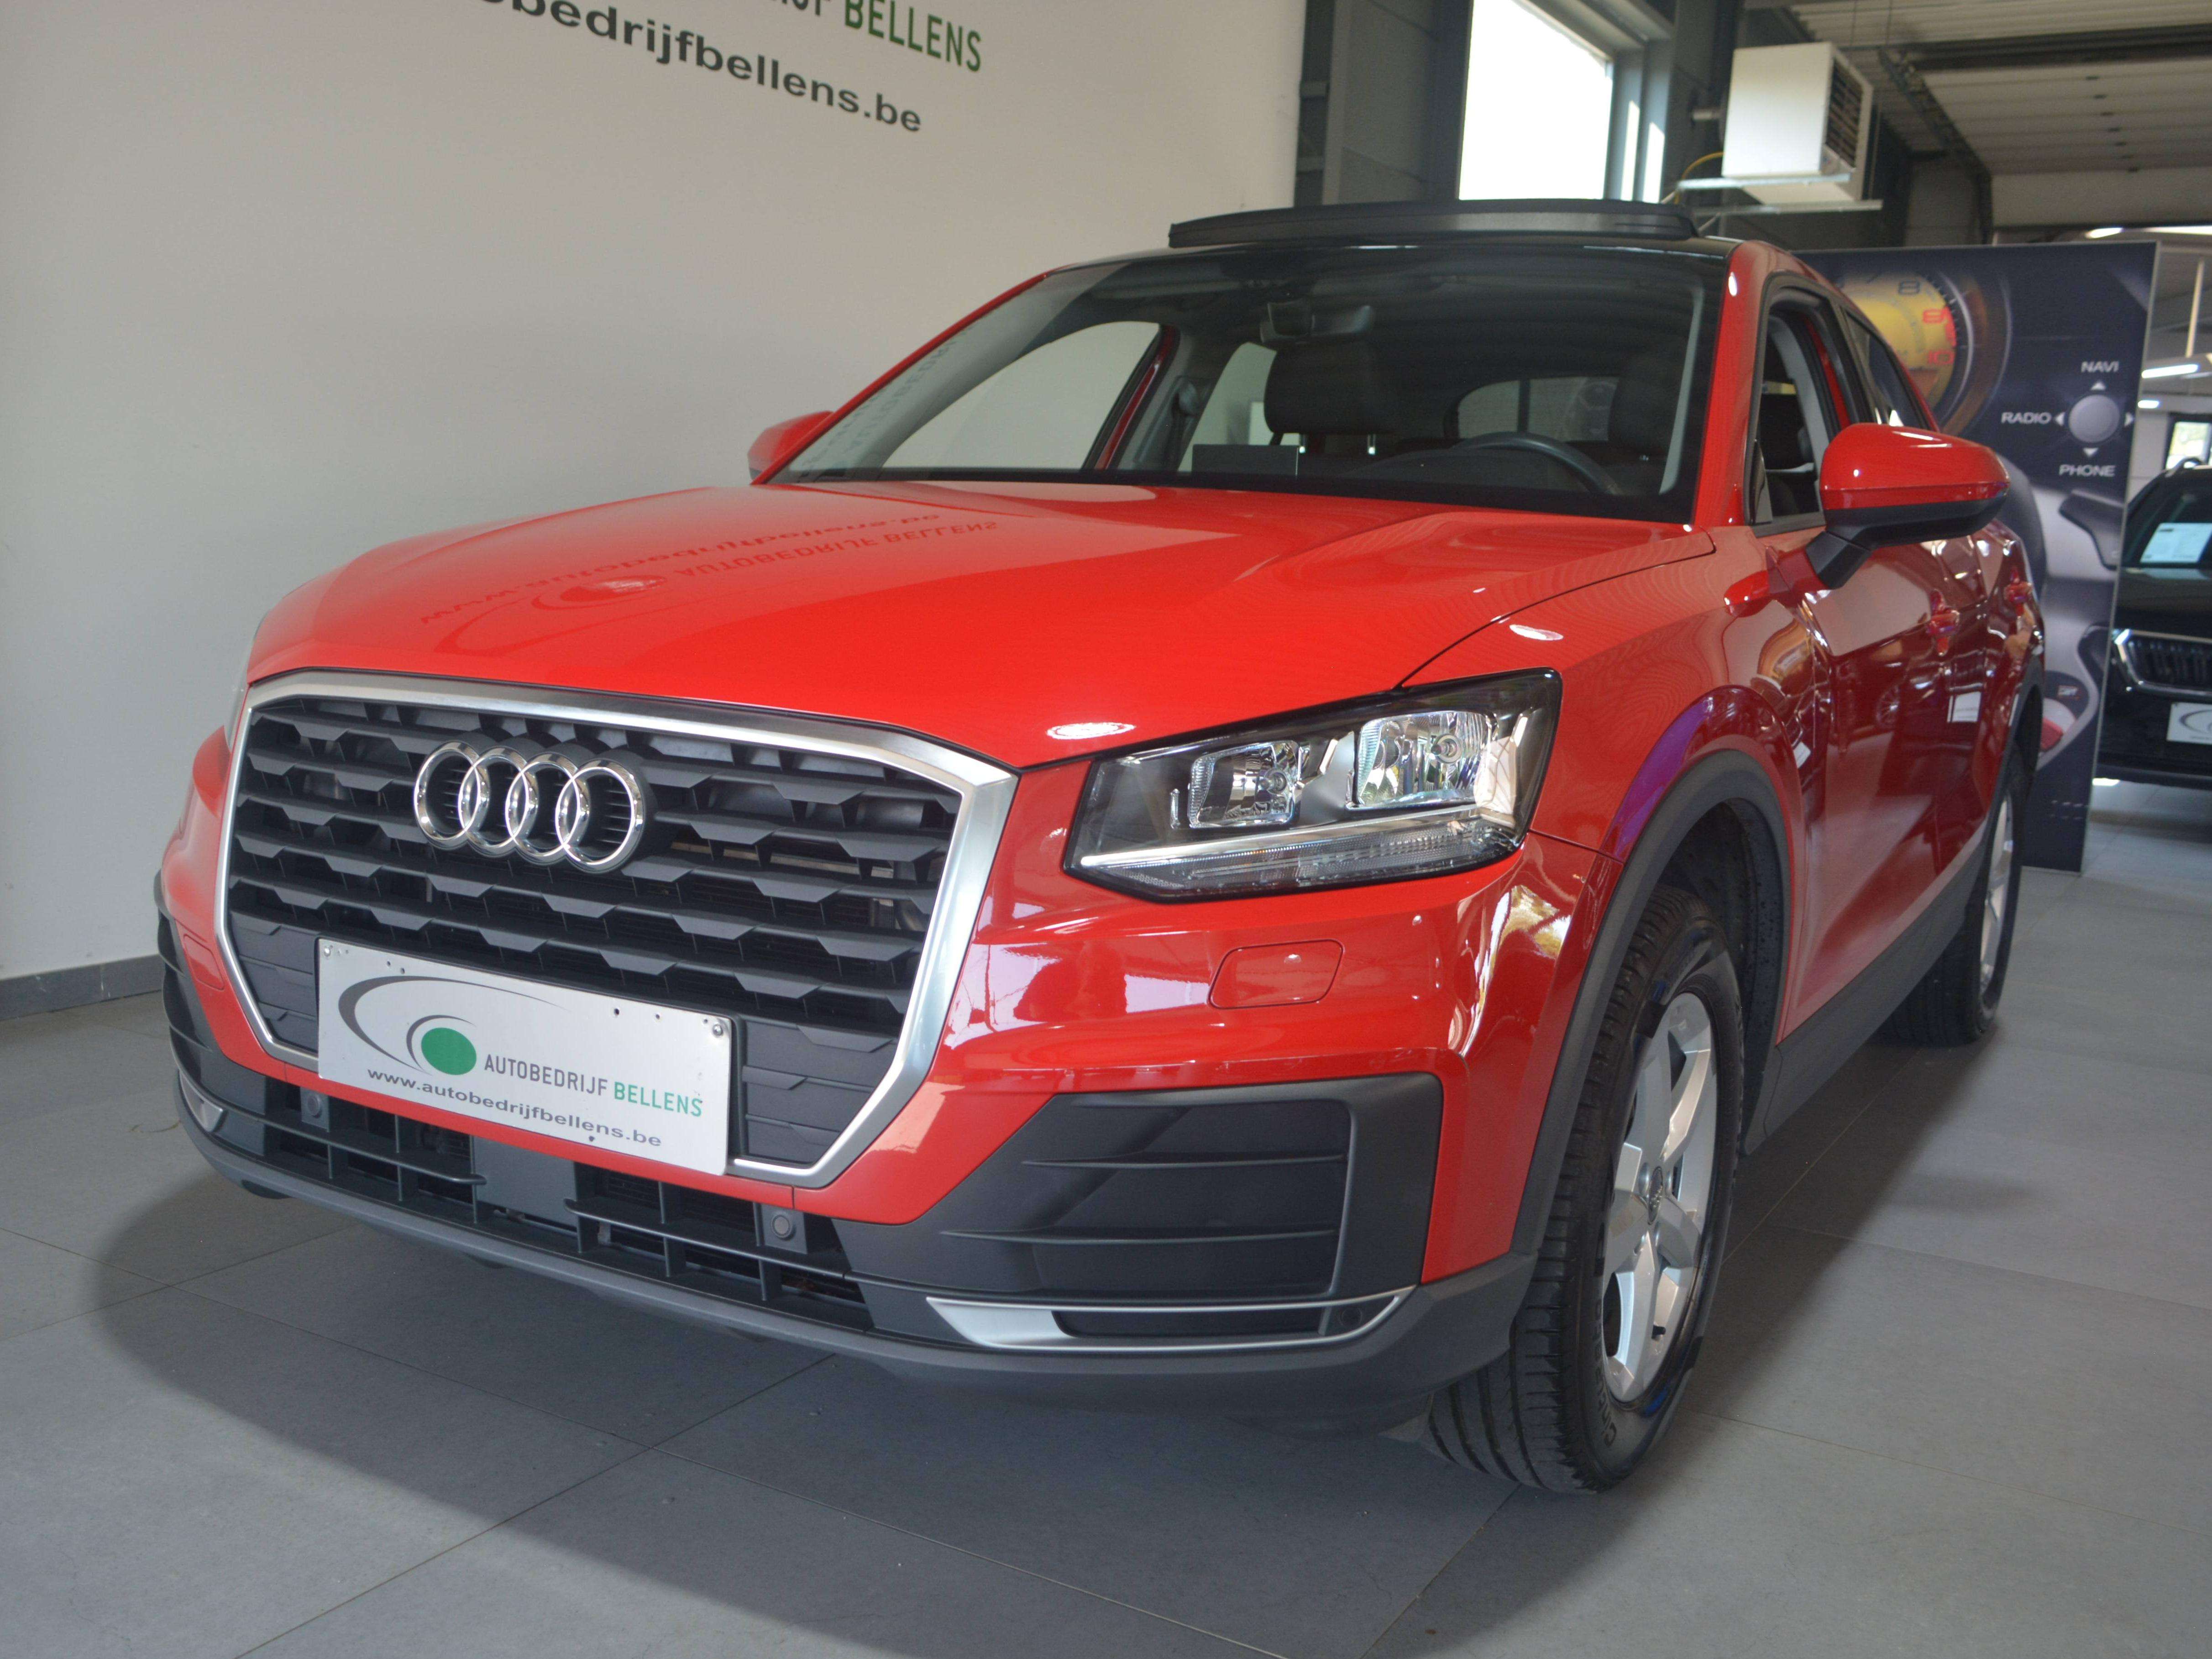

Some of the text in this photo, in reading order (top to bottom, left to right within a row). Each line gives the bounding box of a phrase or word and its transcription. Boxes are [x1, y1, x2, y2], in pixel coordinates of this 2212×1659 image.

[482, 0, 921, 132] edrijfbellens.be
[845, 0, 981, 72] BELLENS
[2081, 361, 2119, 373] NAVI
[2001, 412, 2052, 424] RADIO
[2059, 464, 2117, 477] PHONE
[367, 1069, 662, 1147] www.autobedrijfbellens.be
[484, 1054, 703, 1118] AUTOBEDRIJF BELLENS
